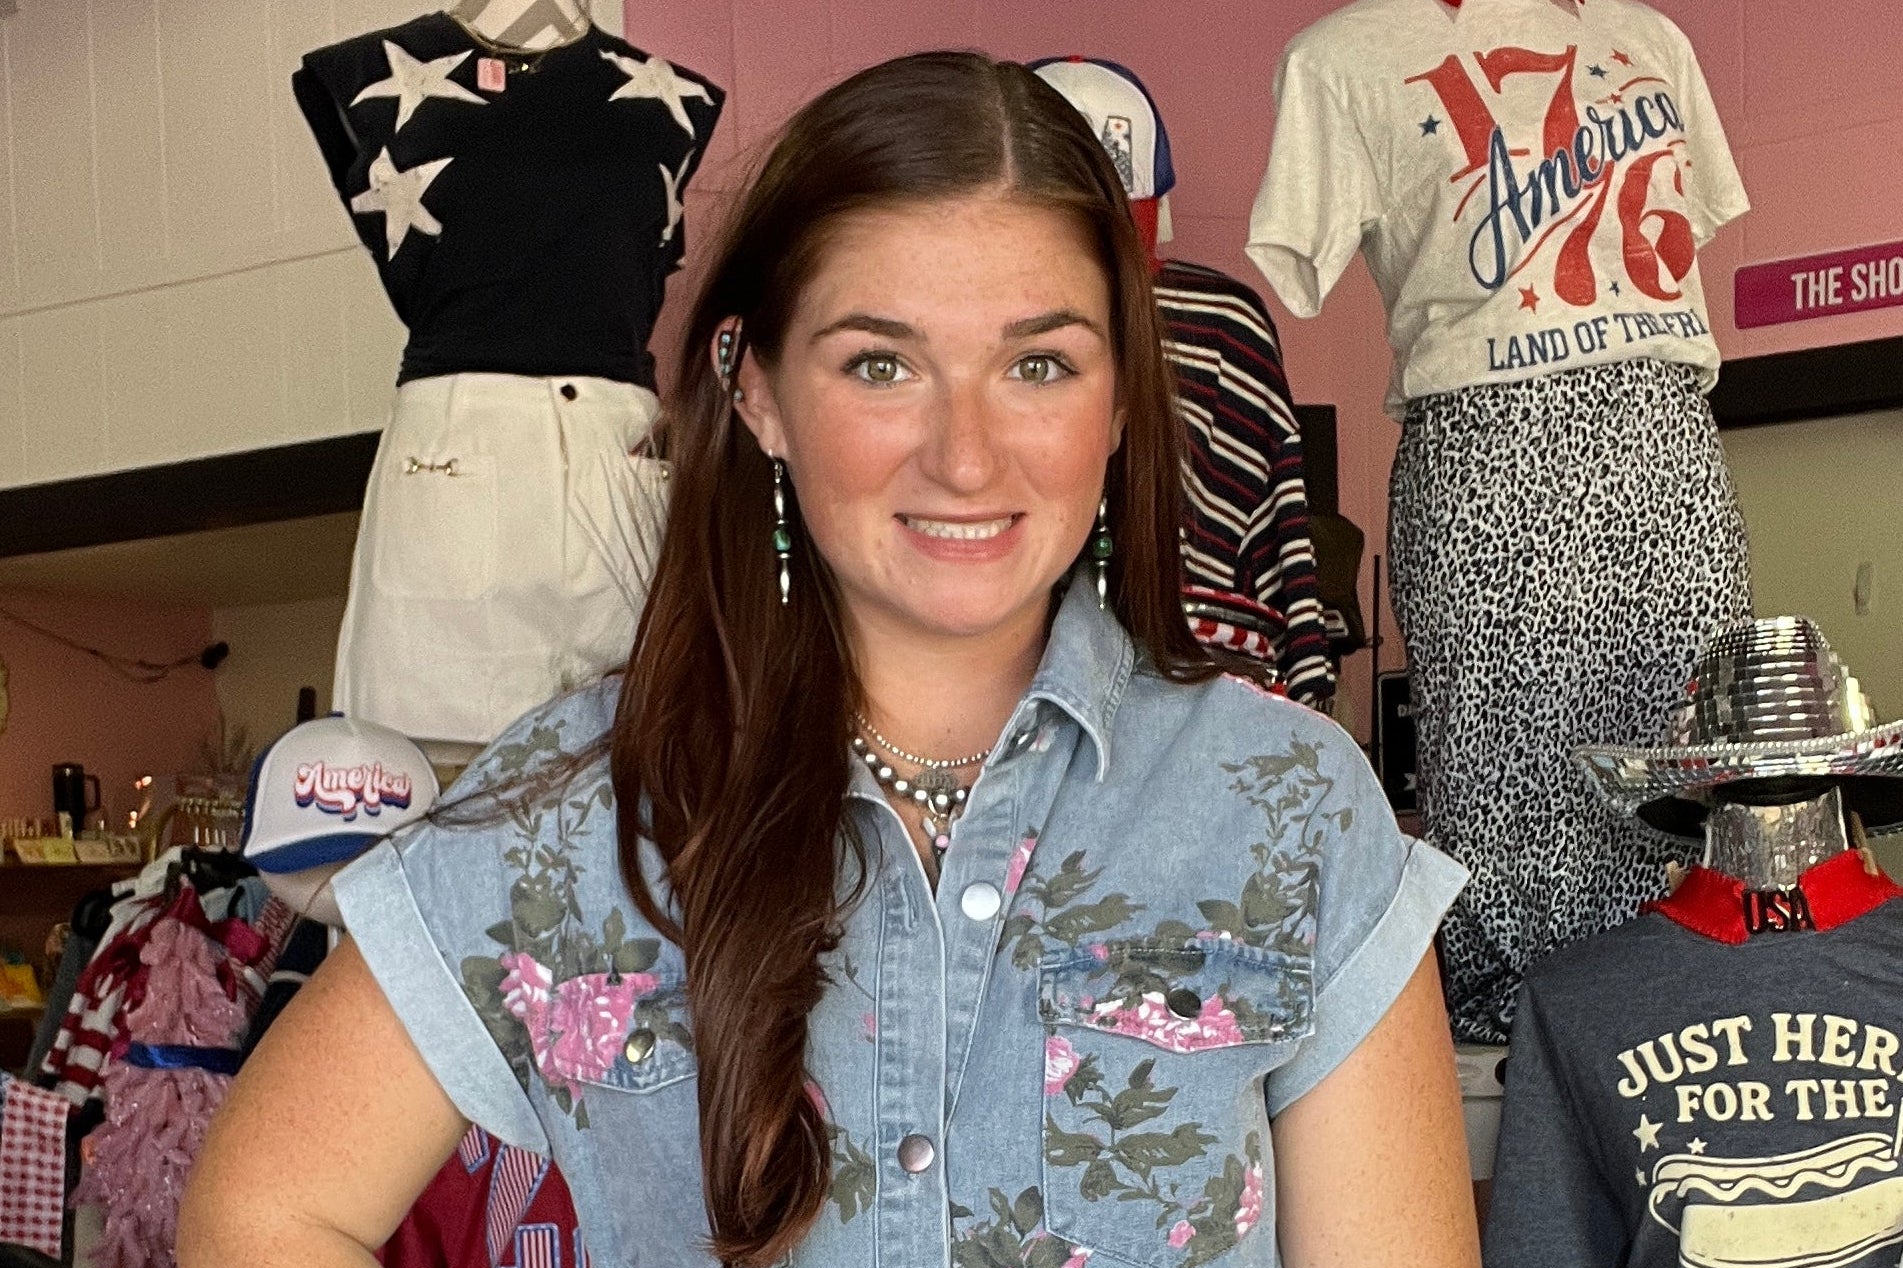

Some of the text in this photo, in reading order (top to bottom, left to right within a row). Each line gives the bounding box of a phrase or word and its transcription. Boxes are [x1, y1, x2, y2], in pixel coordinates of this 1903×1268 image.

[1405, 45, 1580, 186] 17
[1469, 92, 1684, 289] America
[1553, 150, 1696, 306] 76
[1790, 266, 1844, 311] THE
[1487, 328, 1570, 372] LAND
[1573, 316, 1610, 355] OF
[294, 760, 411, 822] America
[1742, 887, 1817, 935] USA
[1616, 1012, 1903, 1098] JUST HER
[1674, 1078, 1894, 1123] FOR THE
